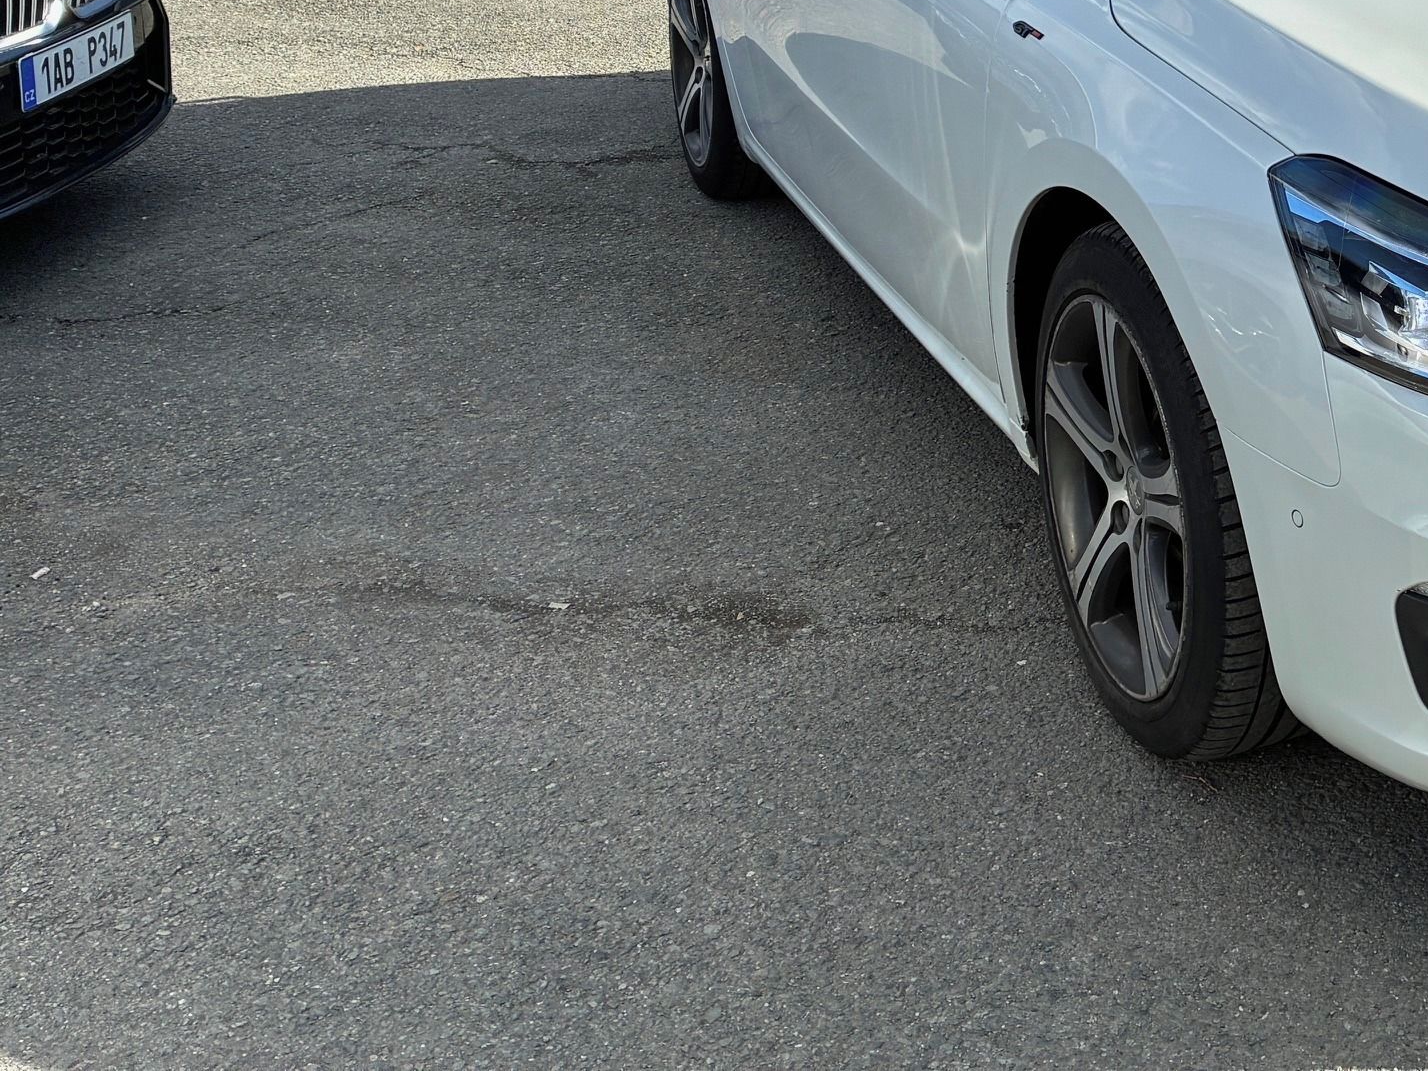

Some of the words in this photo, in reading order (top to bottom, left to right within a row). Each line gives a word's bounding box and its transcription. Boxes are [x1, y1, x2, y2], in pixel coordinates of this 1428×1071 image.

[24, 89, 36, 103] CZ
[41, 47, 75, 95] 1AB
[87, 20, 126, 75] P347
